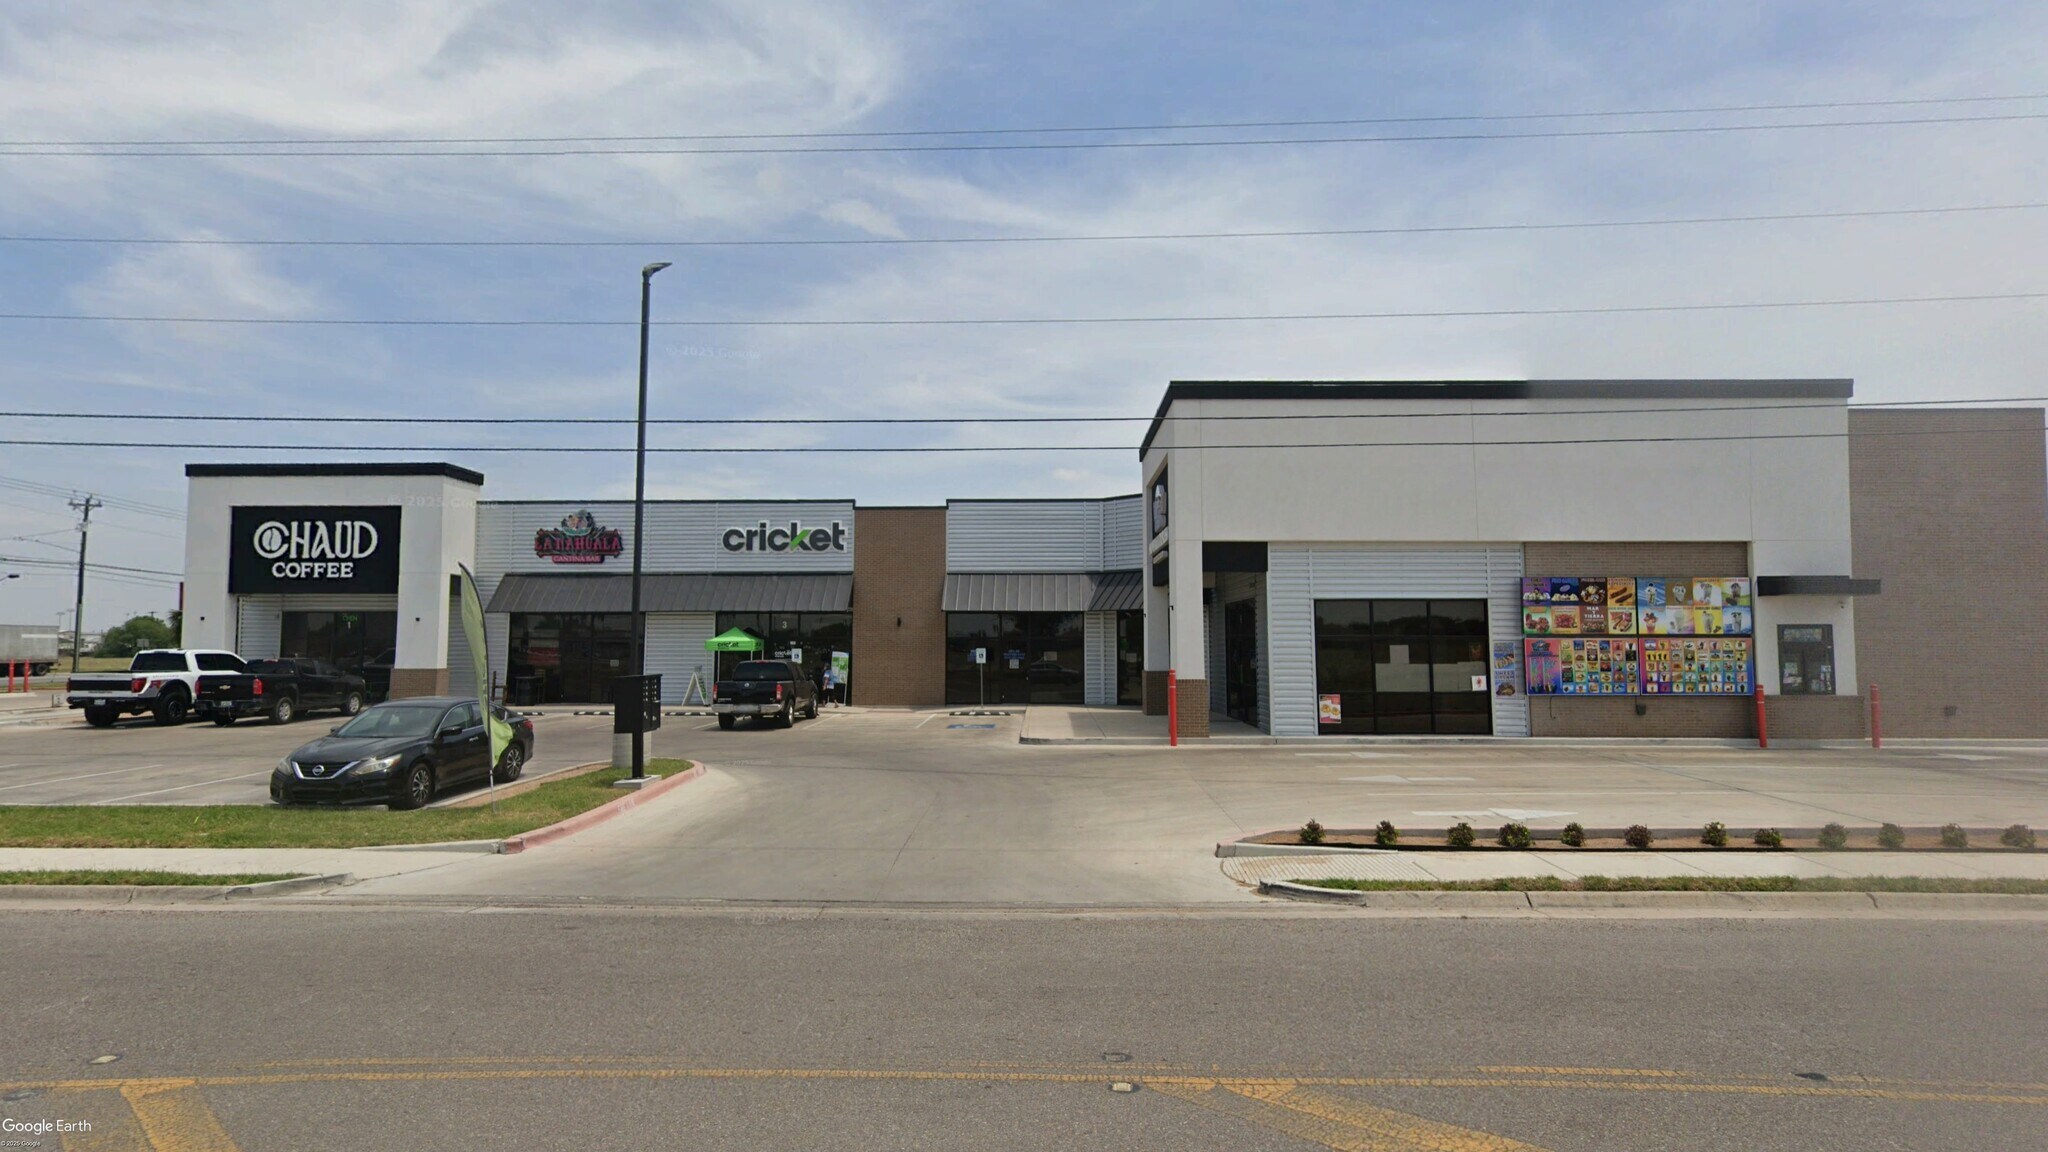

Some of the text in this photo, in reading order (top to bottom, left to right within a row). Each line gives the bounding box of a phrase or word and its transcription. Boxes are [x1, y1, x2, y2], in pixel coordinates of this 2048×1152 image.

[253, 521, 379, 559] CHAUD
[721, 521, 847, 552] cricket
[271, 562, 354, 578] COFFEE
